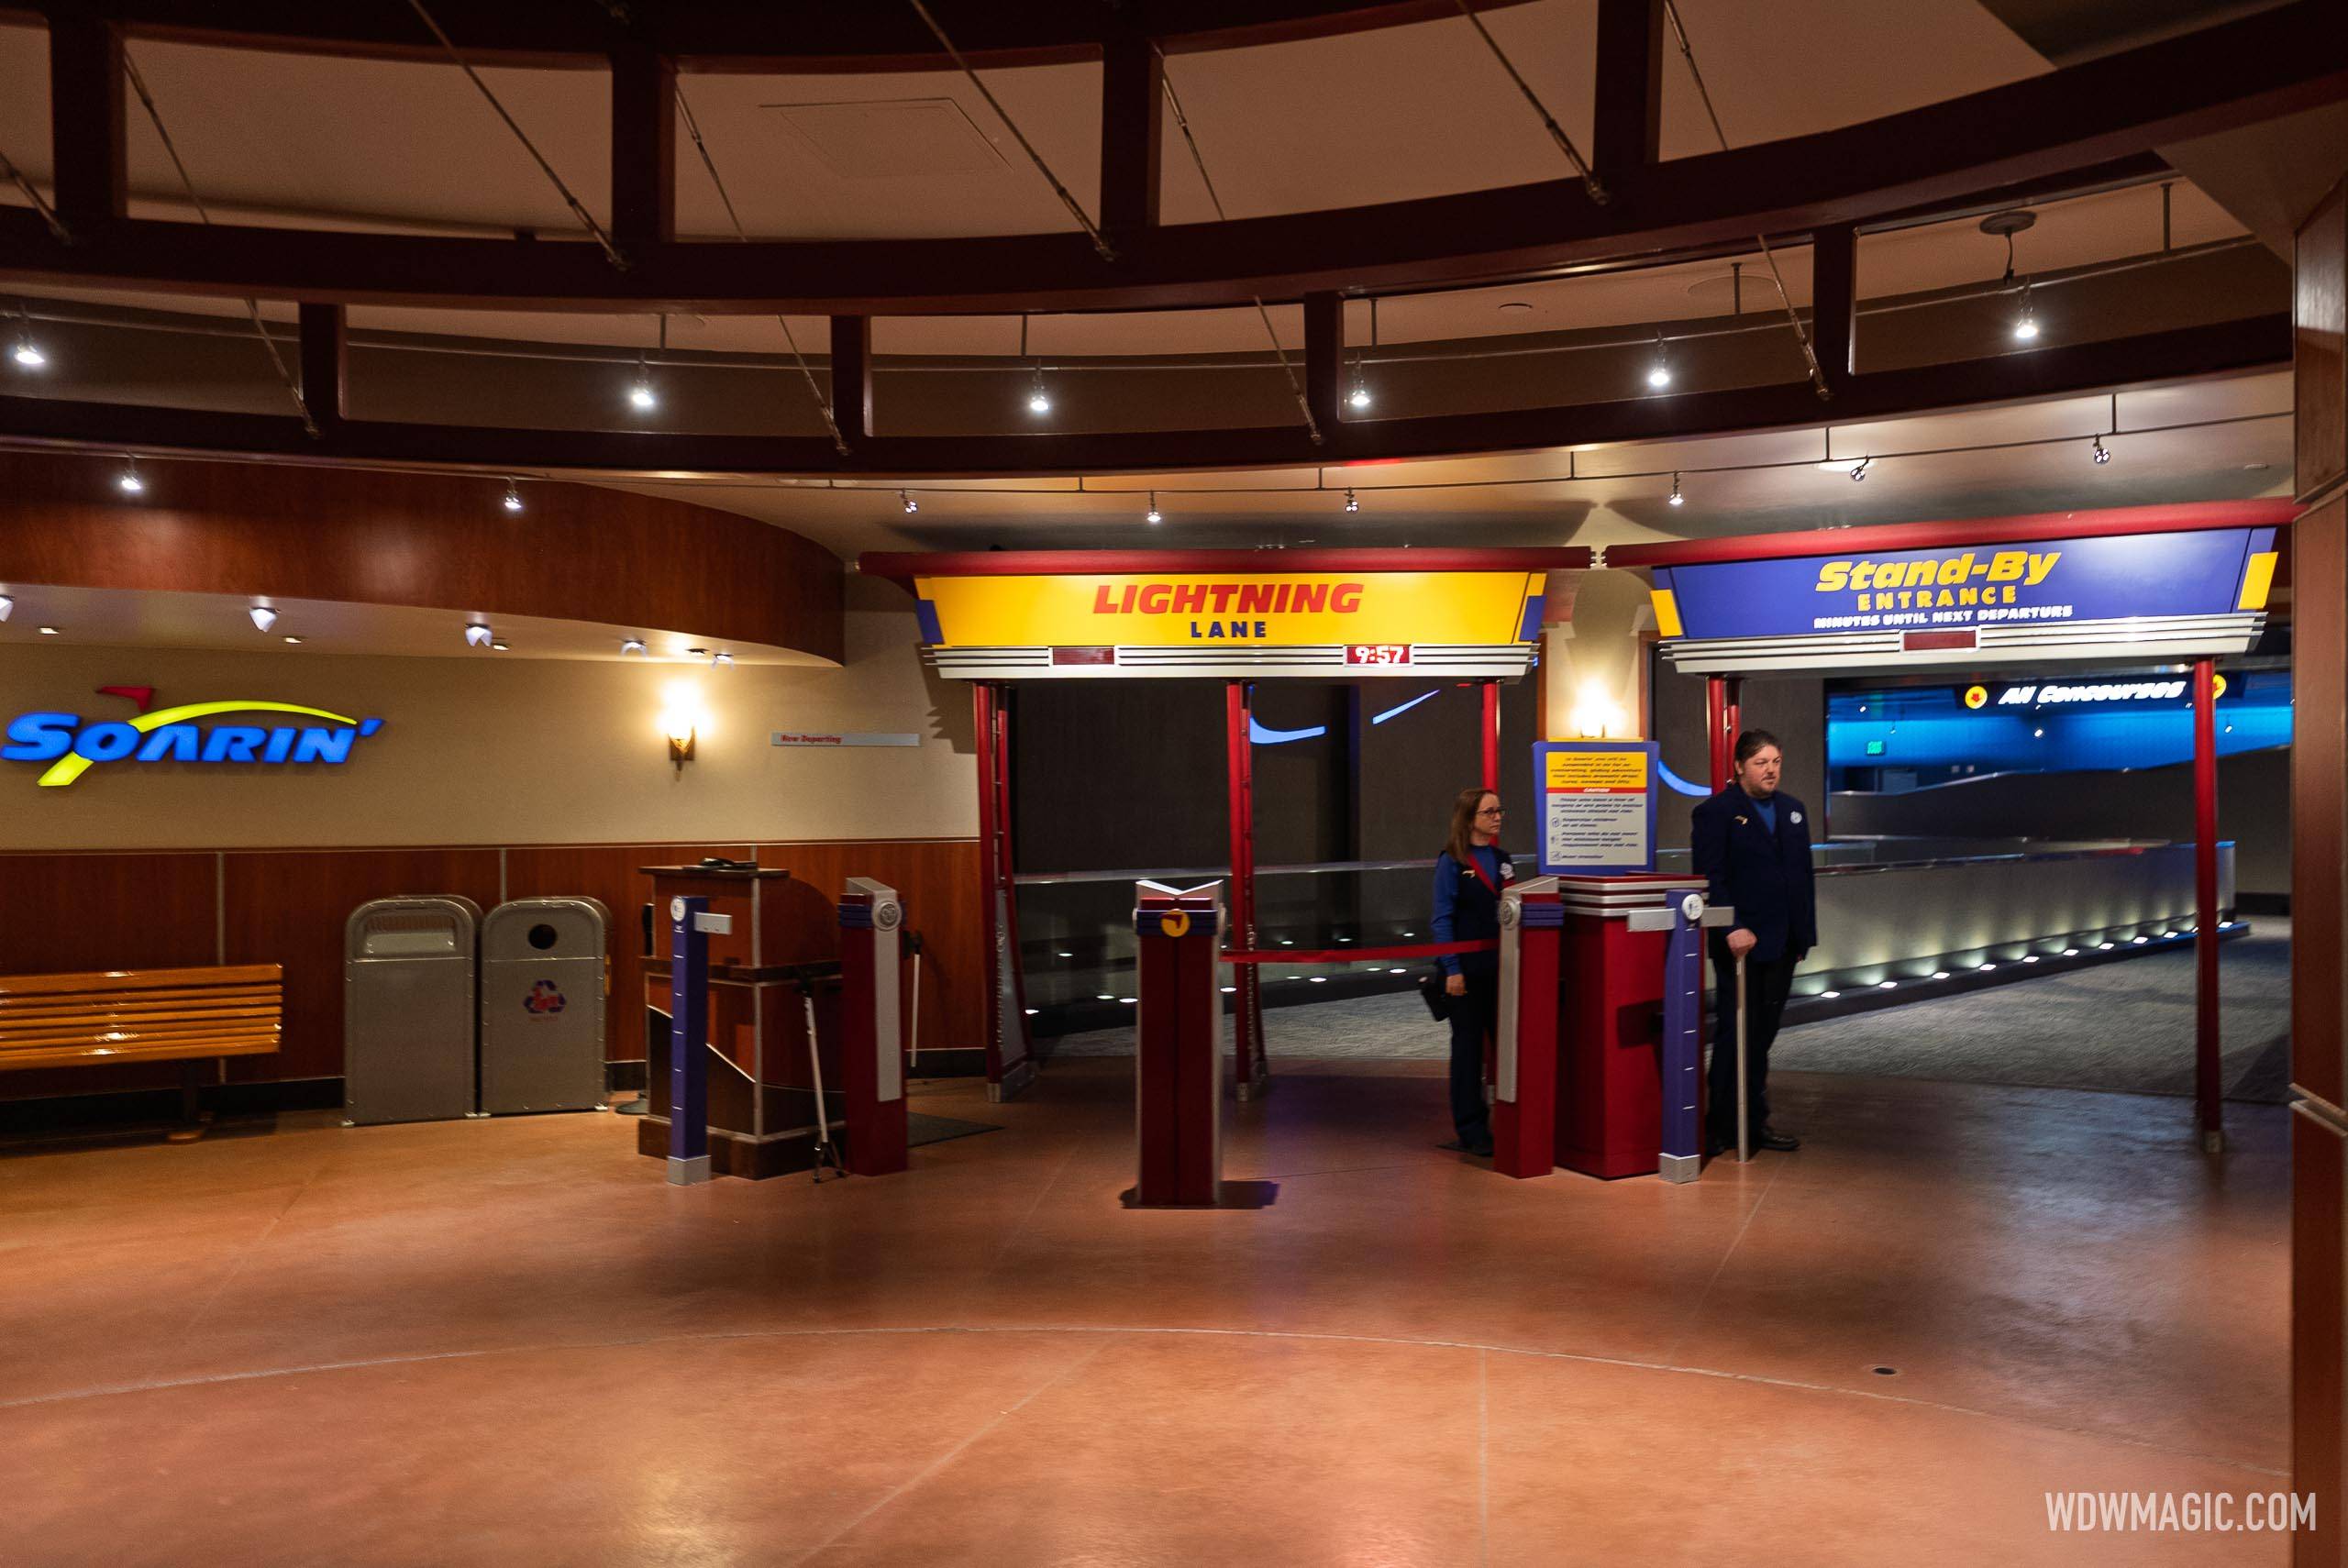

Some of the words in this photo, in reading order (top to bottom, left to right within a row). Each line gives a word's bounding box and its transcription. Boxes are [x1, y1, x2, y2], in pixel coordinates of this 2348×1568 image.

[1815, 551, 2062, 591] Stand-By
[1092, 583, 1365, 613] LIGHTNING
[1857, 585, 2018, 612] ENTRANCE
[1191, 621, 1267, 637] LANE
[1813, 614, 1880, 629] MINUTES
[1883, 612, 1929, 625] UNTIL
[1932, 610, 1973, 624] NEXT
[1977, 605, 2073, 621] DEPARTURE
[1355, 646, 1404, 664] 9:57
[1998, 686, 2037, 704] All
[2037, 681, 2187, 703] Concourses
[0, 712, 385, 763] SOARIN'
